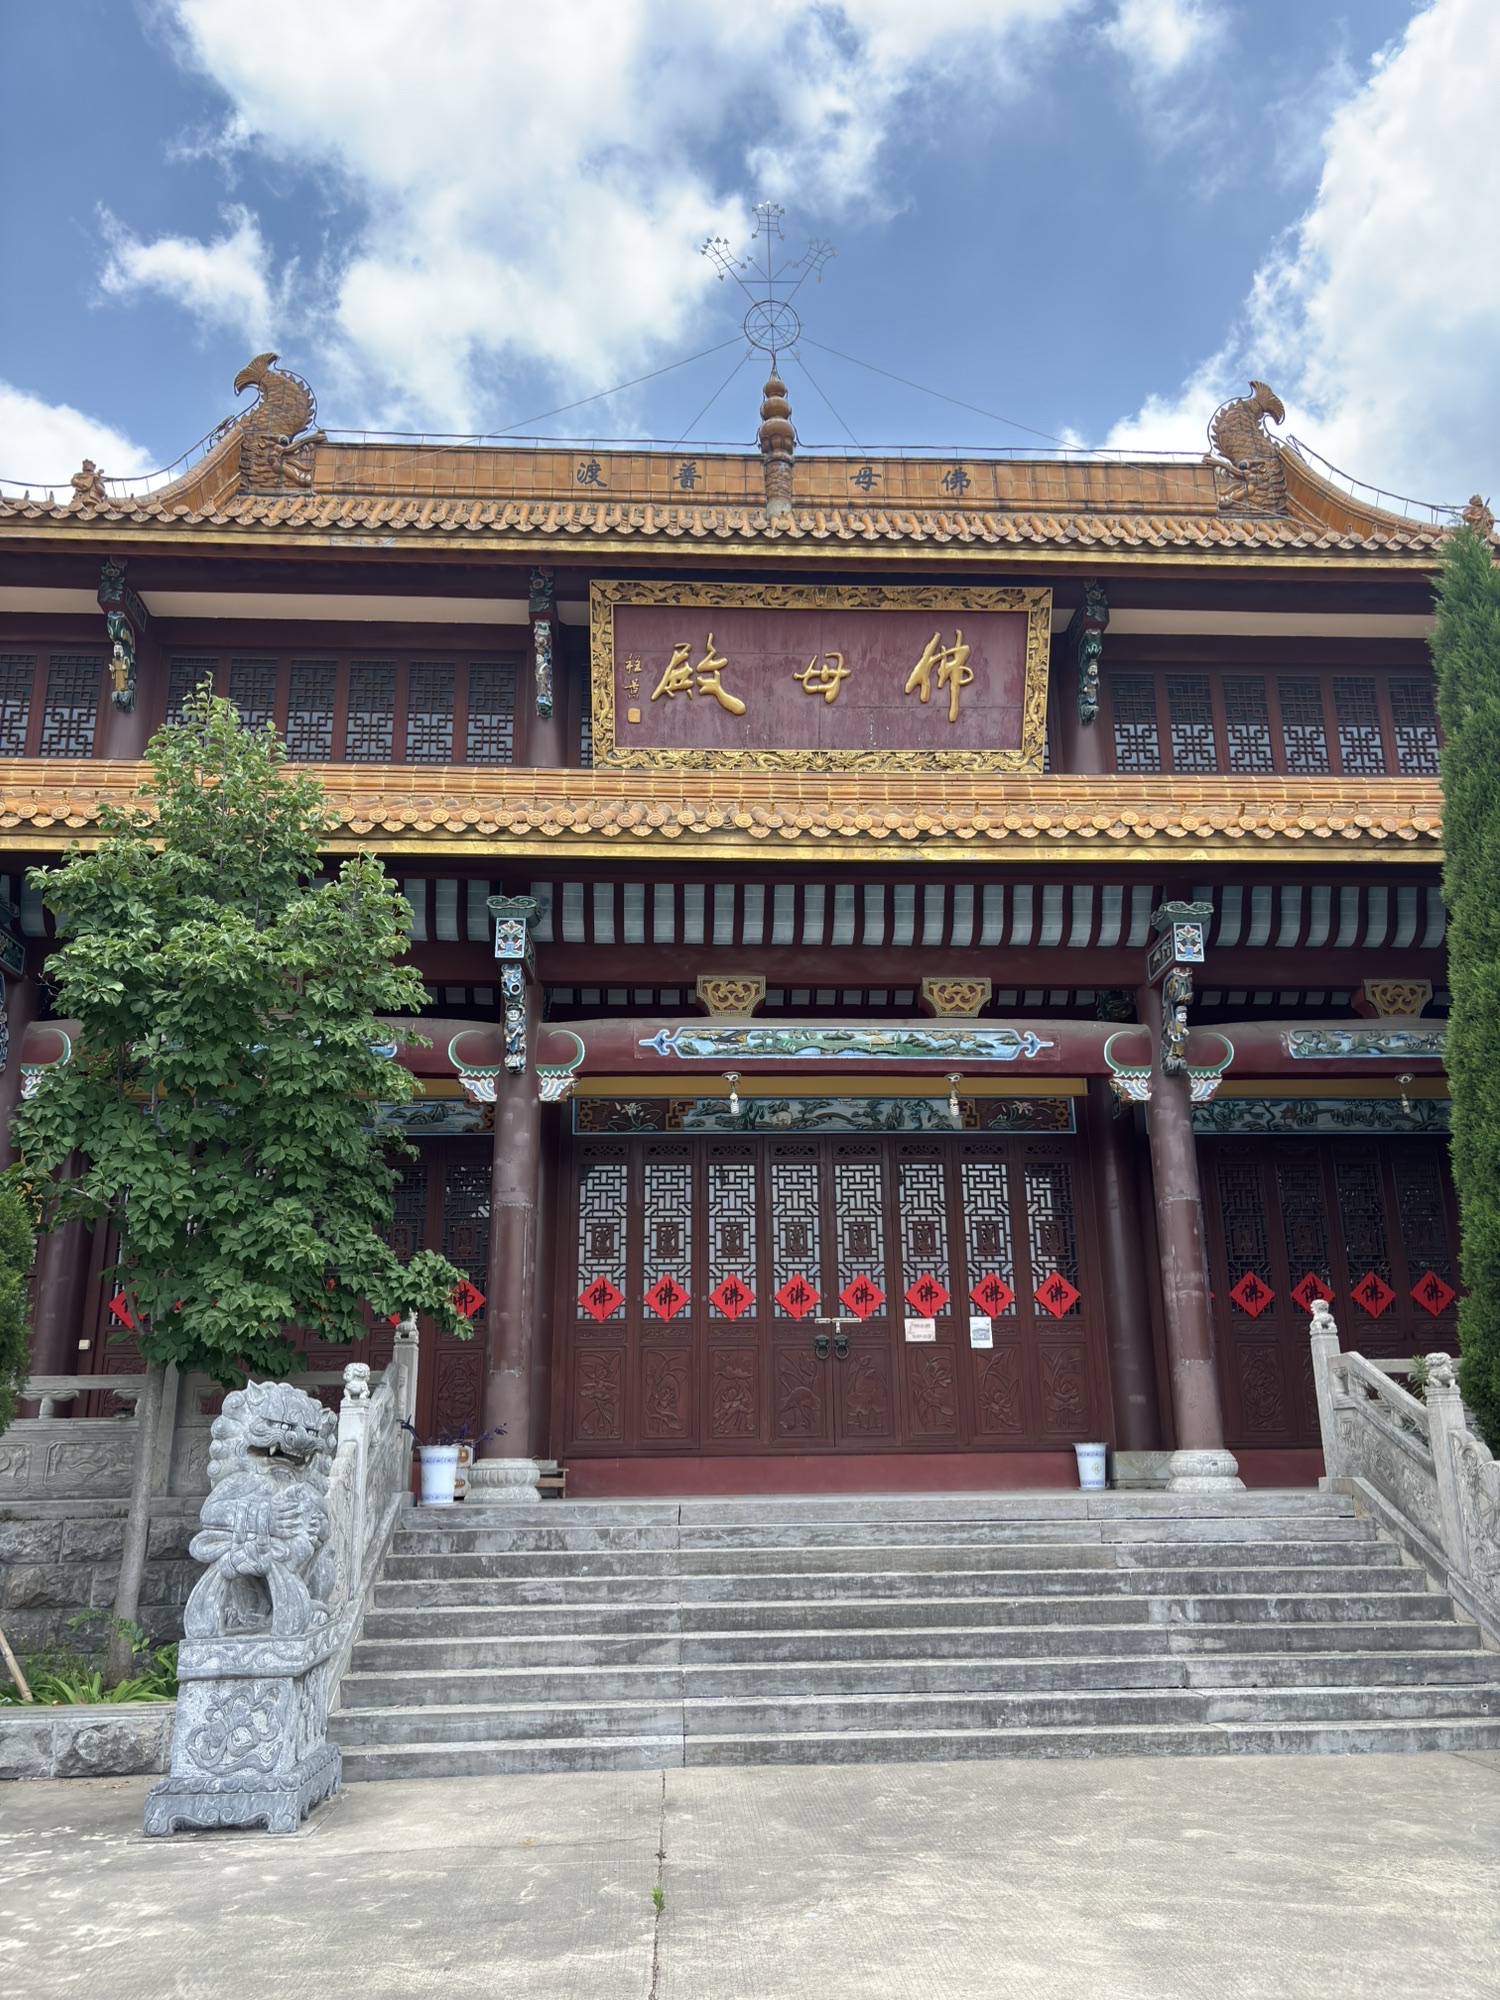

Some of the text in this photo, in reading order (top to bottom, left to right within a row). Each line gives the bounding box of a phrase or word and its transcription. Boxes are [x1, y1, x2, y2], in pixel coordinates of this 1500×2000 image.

[651, 629, 974, 723] 佛母殿
[589, 1280, 613, 1318] 佛
[656, 1279, 679, 1317] 佛
[721, 1280, 744, 1316] 佛
[787, 1280, 810, 1317] 佛
[852, 1280, 874, 1315] 佛
[916, 1279, 938, 1314] 佛
[981, 1278, 1004, 1314] 佛
[1046, 1278, 1069, 1314] 佛
[1241, 1276, 1264, 1312] 佛
[1301, 1277, 1325, 1300] 佛
[1361, 1276, 1384, 1314] 佛
[1423, 1276, 1444, 1312] 佛
